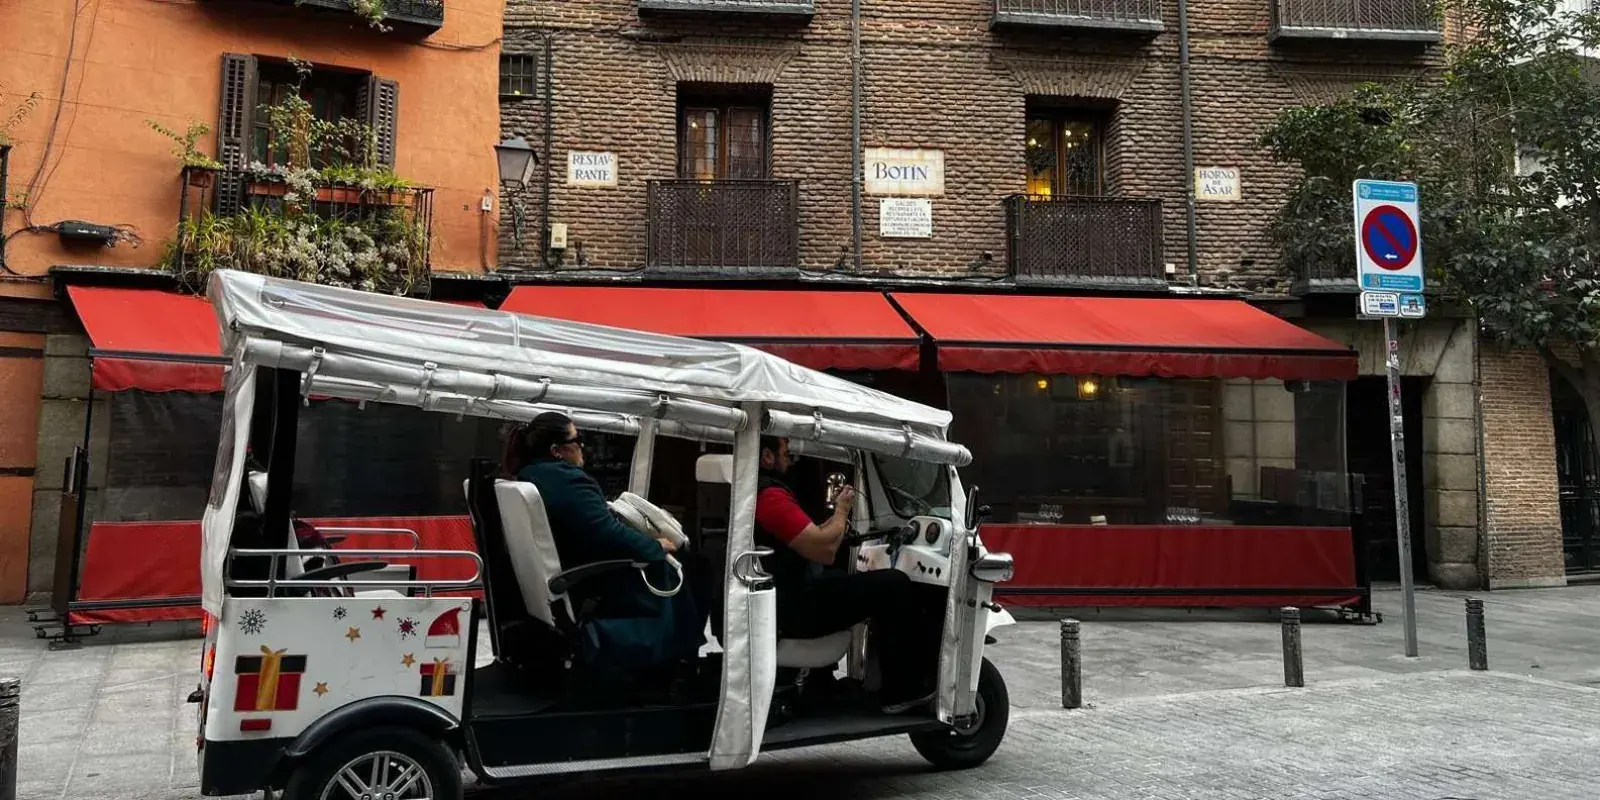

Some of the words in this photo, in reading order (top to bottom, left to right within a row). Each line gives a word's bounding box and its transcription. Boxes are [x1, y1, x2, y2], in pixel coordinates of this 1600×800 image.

[575, 169, 611, 180] RANTE
[1199, 170, 1236, 179] HORNO
[1203, 184, 1233, 195] ASAR
